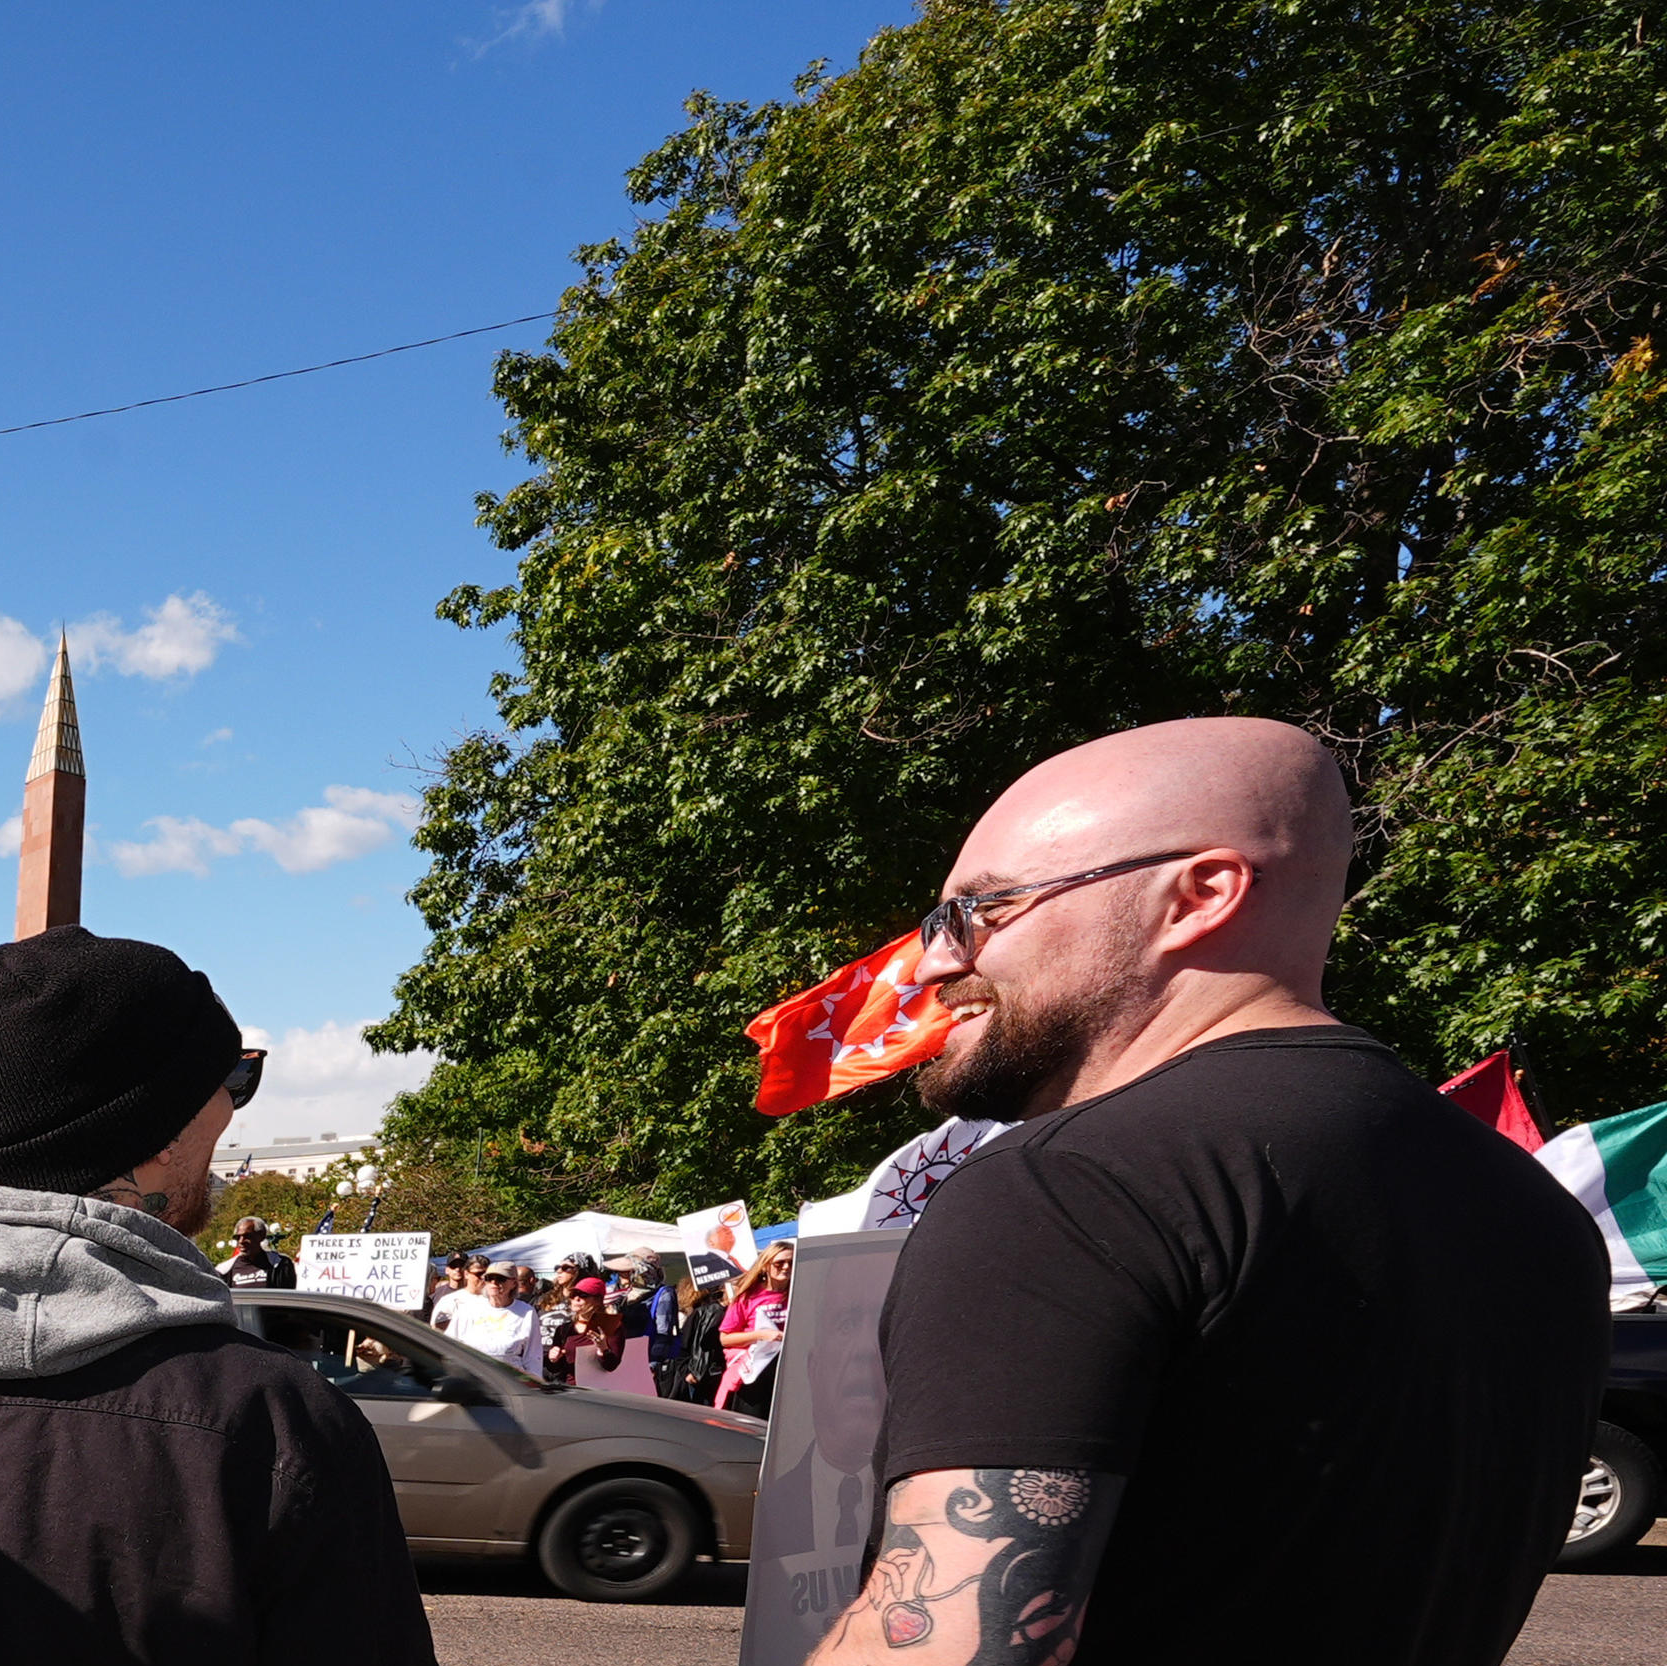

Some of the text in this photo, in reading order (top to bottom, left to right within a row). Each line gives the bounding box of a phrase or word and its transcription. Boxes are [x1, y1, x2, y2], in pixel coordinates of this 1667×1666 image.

[309, 1236, 427, 1247] THERE IS ONLY ONE
[316, 1251, 346, 1260] KING
[371, 1249, 418, 1260] JESUS
[318, 1265, 351, 1280] ALL
[367, 1264, 402, 1280] ARE
[694, 1265, 708, 1276] NO
[696, 1269, 731, 1286] KINGS!
